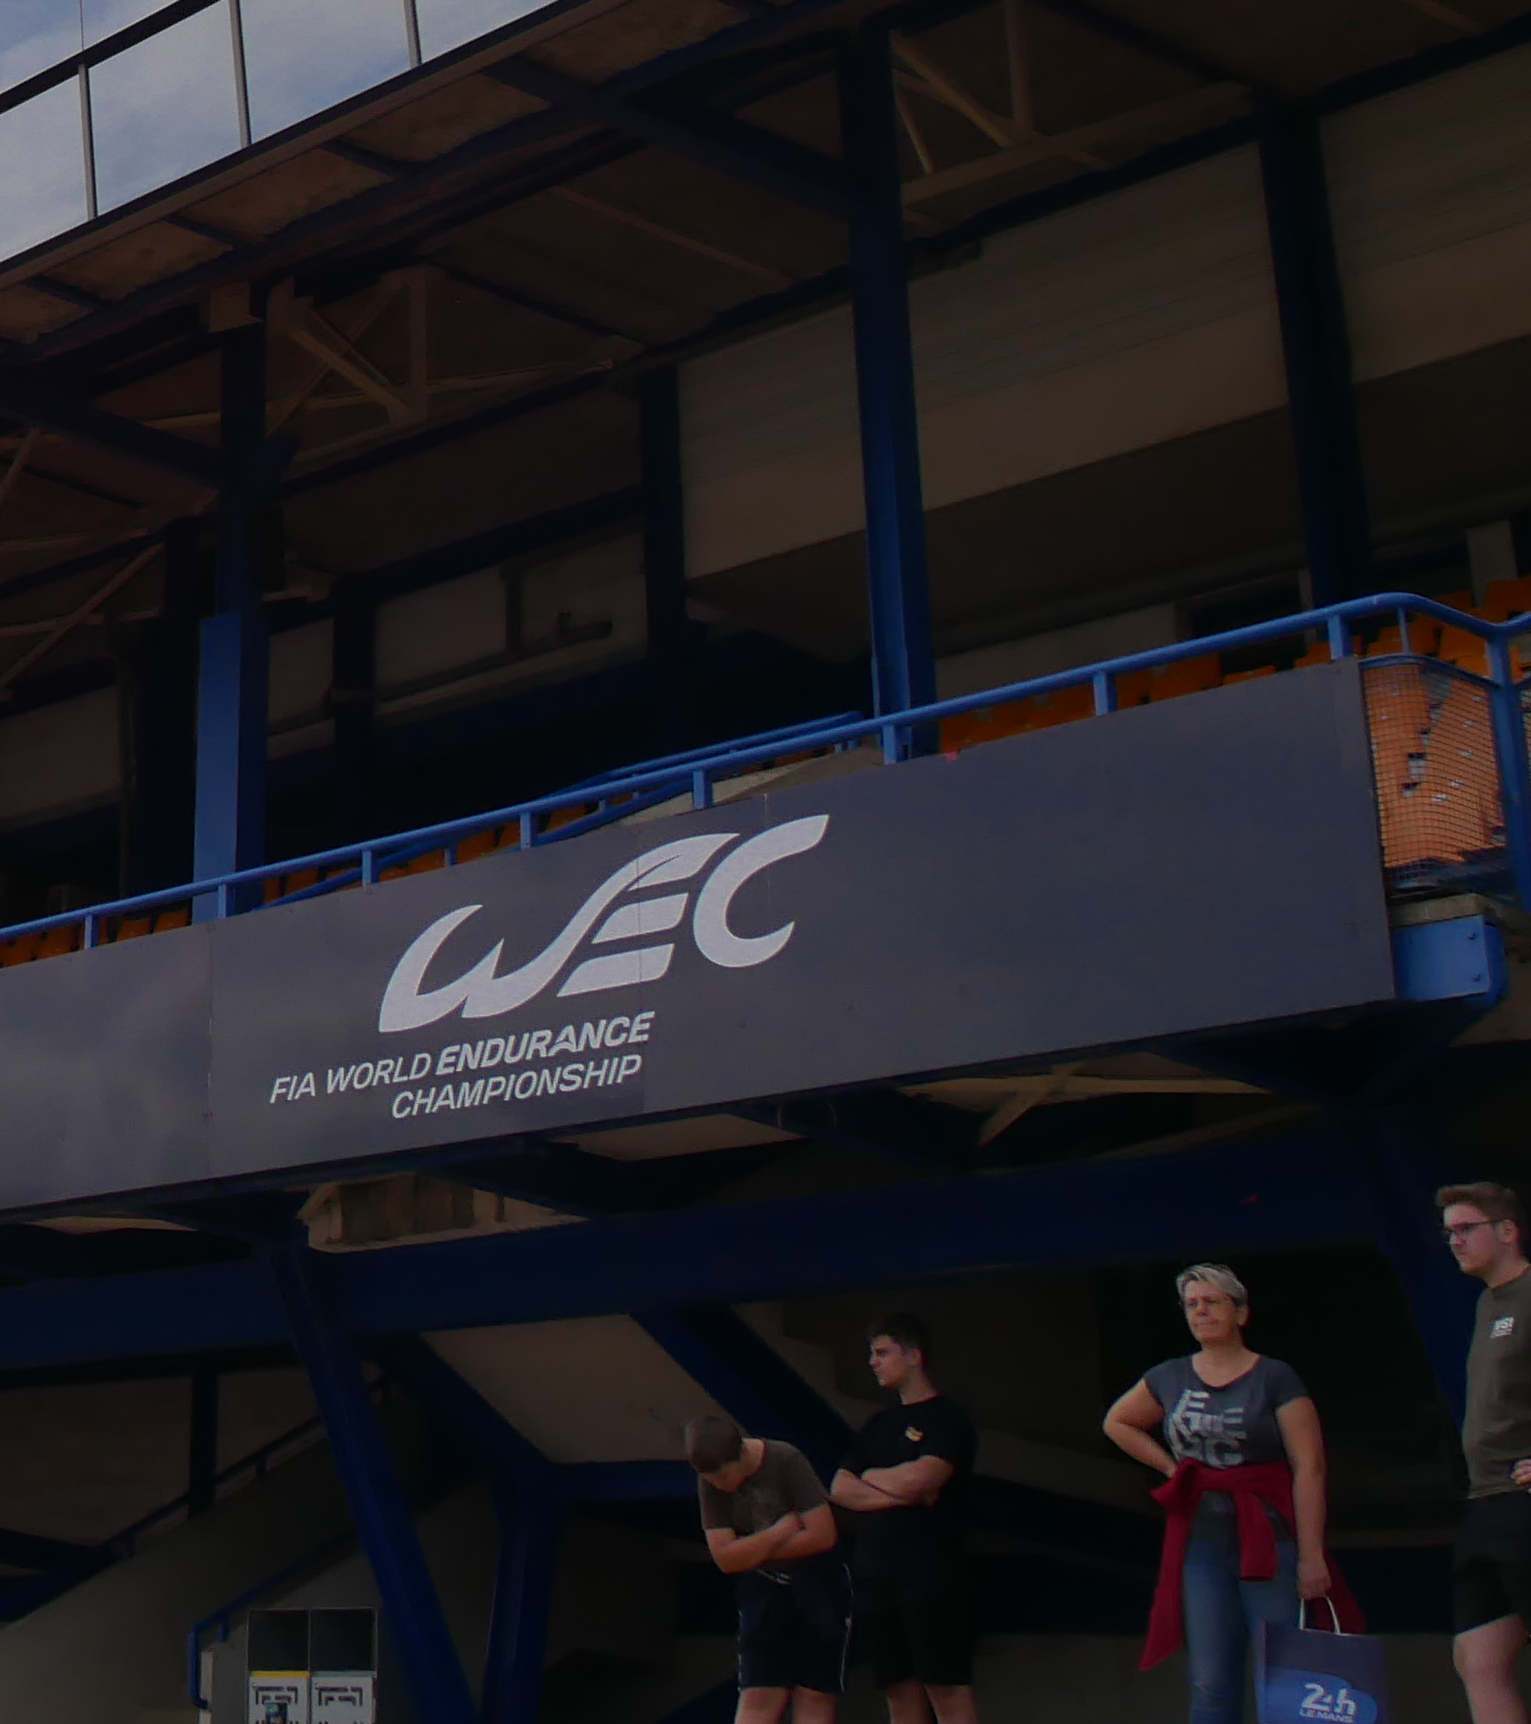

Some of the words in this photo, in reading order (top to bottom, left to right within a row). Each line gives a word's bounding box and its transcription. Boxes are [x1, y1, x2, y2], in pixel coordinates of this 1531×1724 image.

[379, 813, 830, 1033] WEC
[270, 1071, 316, 1104] FIA
[327, 1052, 432, 1094] WORLD
[435, 1011, 656, 1076] ENDURANCE
[392, 1054, 643, 1119] CHAMPIONSHIP
